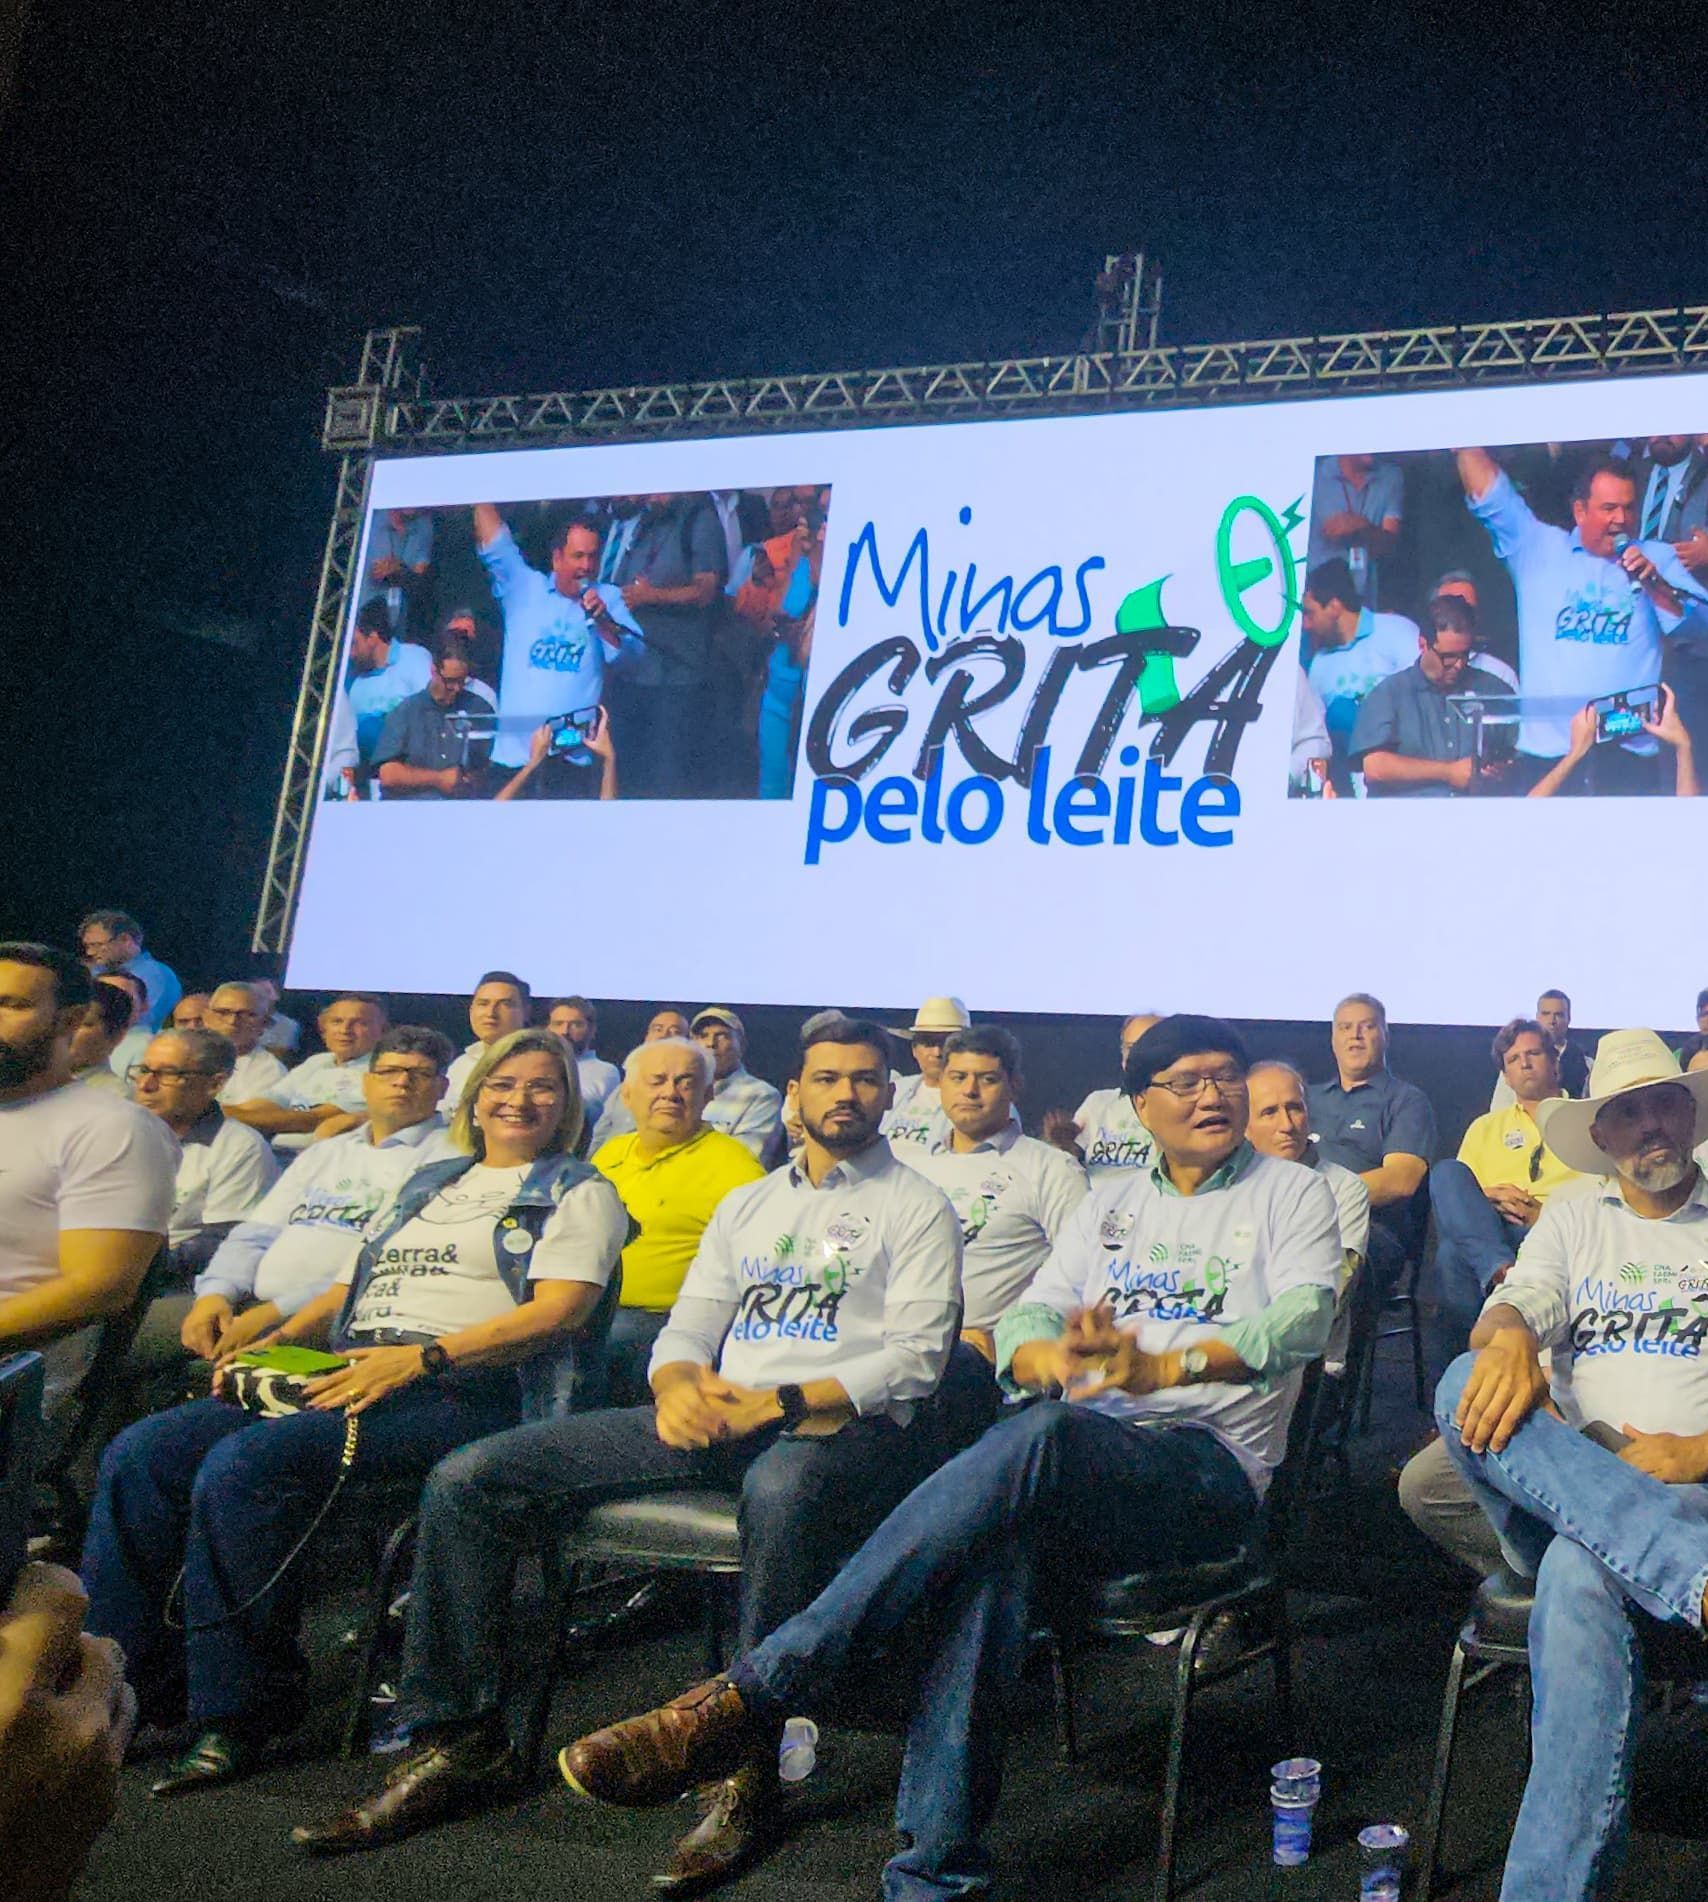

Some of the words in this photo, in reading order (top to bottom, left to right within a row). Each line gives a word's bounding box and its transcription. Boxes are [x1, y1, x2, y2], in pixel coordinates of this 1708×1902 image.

[838, 505, 1106, 651] Minas
[805, 627, 1286, 789] GRITA
[803, 743, 1004, 865] pelo
[1026, 744, 1242, 848] leite
[734, 1315, 772, 1341] elo
[741, 1281, 848, 1326] RITA
[1575, 1275, 1657, 1313] Minas
